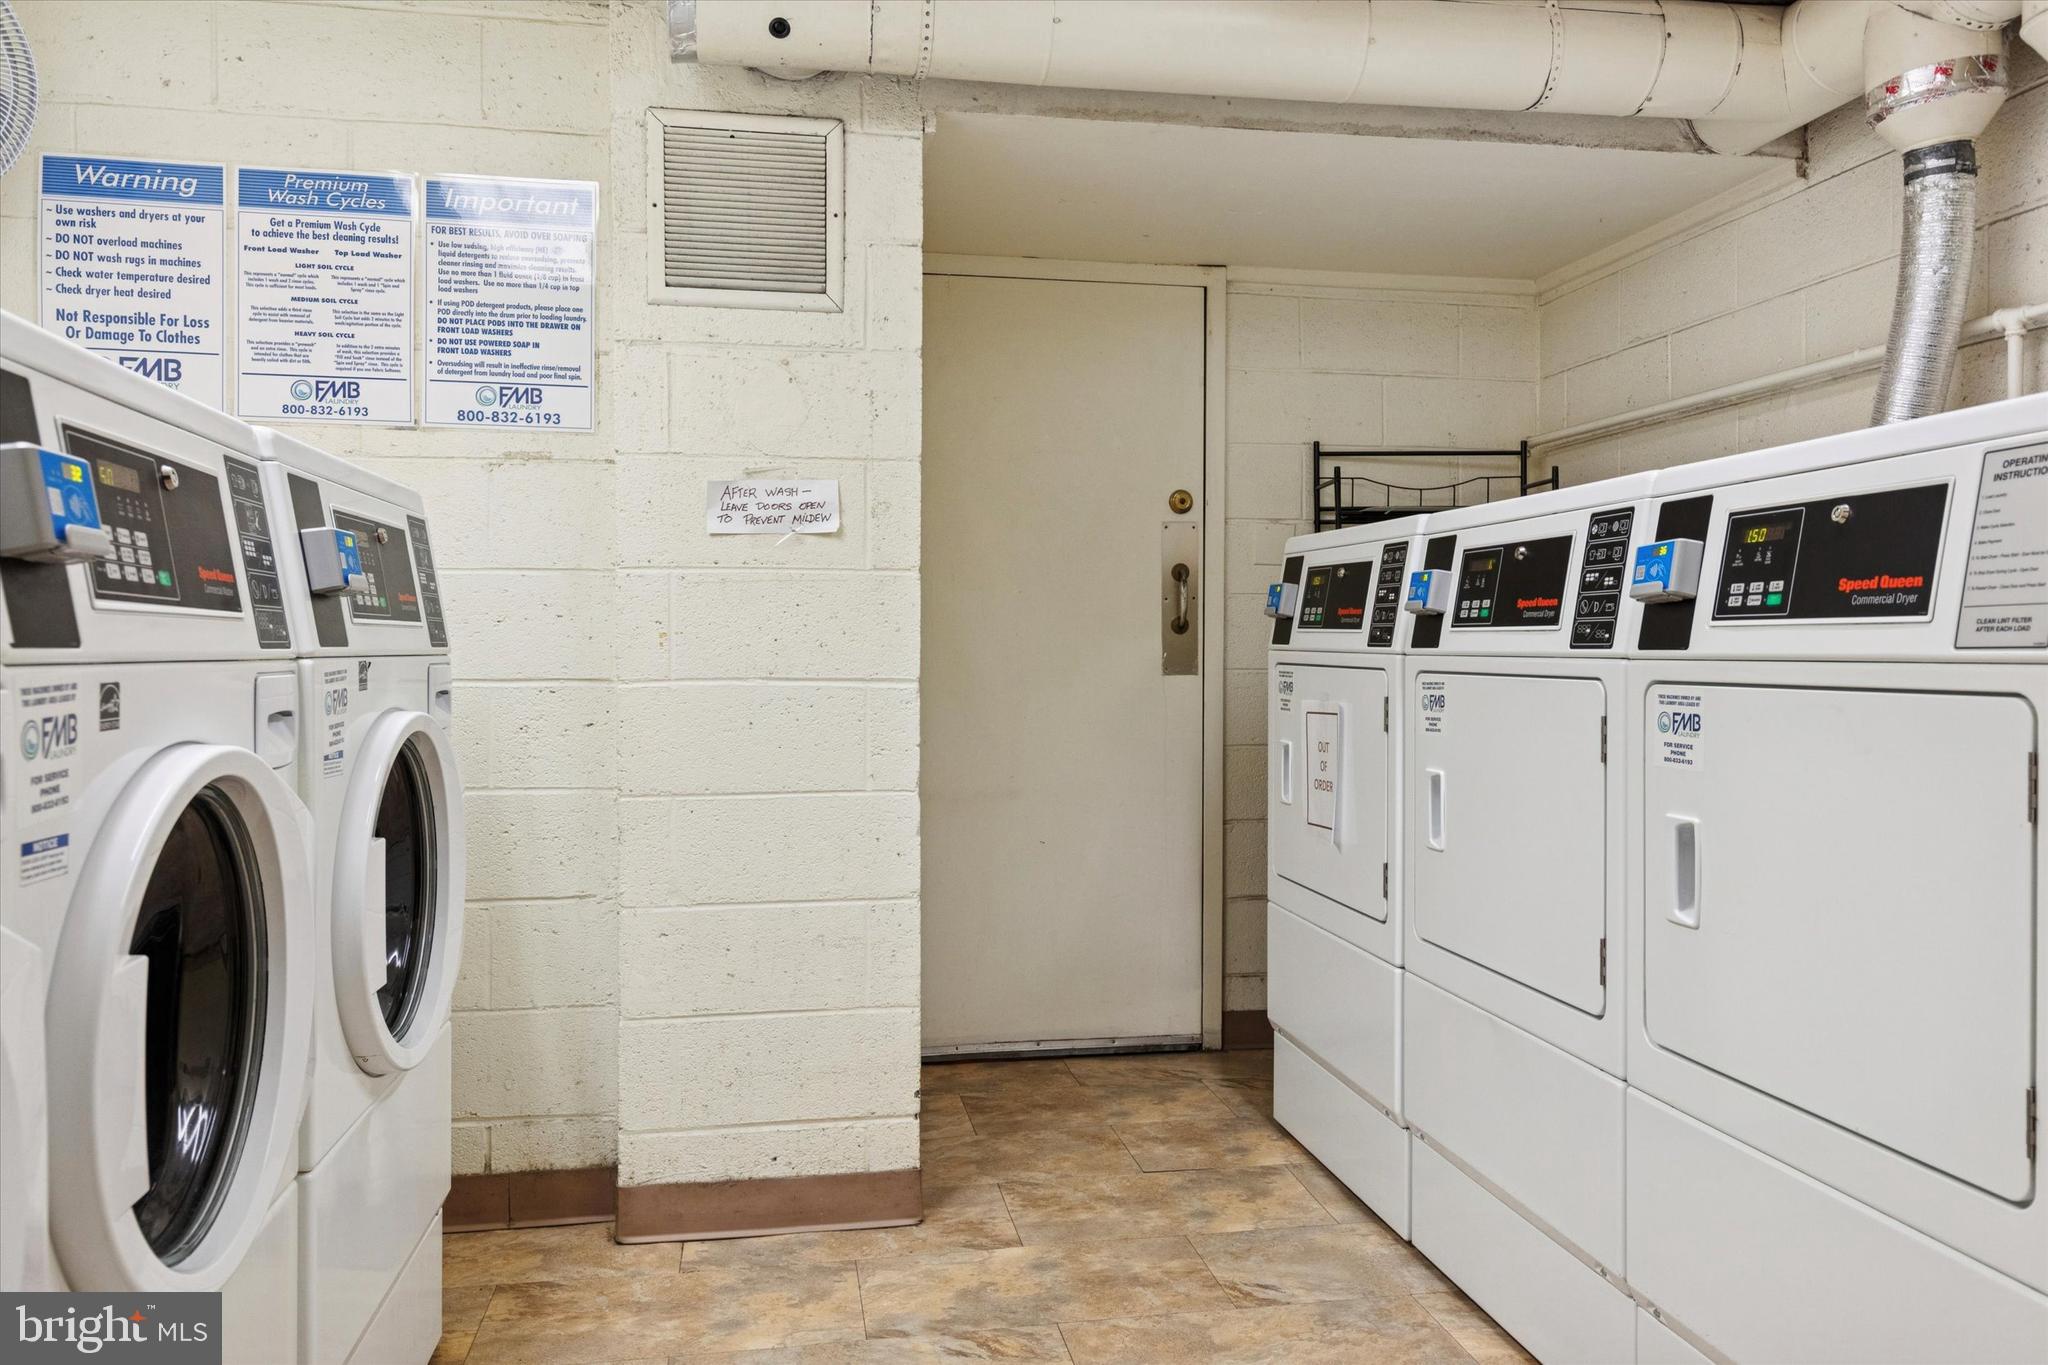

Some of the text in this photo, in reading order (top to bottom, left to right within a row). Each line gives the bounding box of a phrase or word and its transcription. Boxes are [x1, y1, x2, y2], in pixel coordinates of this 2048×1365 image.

[75, 164, 197, 197] Warning
[284, 174, 368, 192] Premium
[268, 189, 386, 210] Wash Cycles
[445, 188, 580, 215] Important
[56, 205, 205, 225] Use washers and dryers at your
[79, 219, 96, 228] risk
[270, 218, 284, 227] Get
[296, 219, 331, 229] Premium
[334, 221, 356, 231] Wash
[360, 221, 380, 234] Cycle
[55, 233, 182, 250] DO NOT overload machines
[252, 229, 399, 244] to achieve the best cleaning results!
[432, 226, 587, 242] FOR BEST RESULTS, AVOID OVER SOAPING
[55, 250, 201, 268] DO NOT wash rugs in machines
[290, 247, 319, 255] Washer
[56, 267, 210, 285] Check water temperature desired
[56, 284, 171, 299] Check dryer heat desired
[56, 309, 209, 328] Not Responsible For Loss
[540, 322, 568, 330] DRAWER
[66, 326, 200, 344] Or Damage To Clothes
[479, 339, 511, 347] POWERED
[437, 360, 472, 369] Oversudsing
[541, 364, 580, 372] rinse/removal
[315, 380, 360, 402] FMB
[500, 386, 542, 408] FMB
[282, 405, 368, 416] 800-832-6193
[458, 410, 560, 424] 800-832-6193
[721, 485, 757, 500] AFTER
[765, 487, 798, 497] WASH
[721, 501, 826, 512] LEAVE DOORS OPEN
[717, 514, 733, 523] TO
[744, 514, 785, 526] PREVENT
[1838, 576, 1923, 593] Speed Queen
[1851, 593, 1919, 605] Commercial Dryer
[1430, 695, 1445, 711] FMB
[1673, 712, 1701, 735] FMB
[42, 713, 78, 759] FMB
[1318, 741, 1330, 753] OUT
[1320, 760, 1327, 772] OF
[1314, 779, 1333, 792] ORDER
